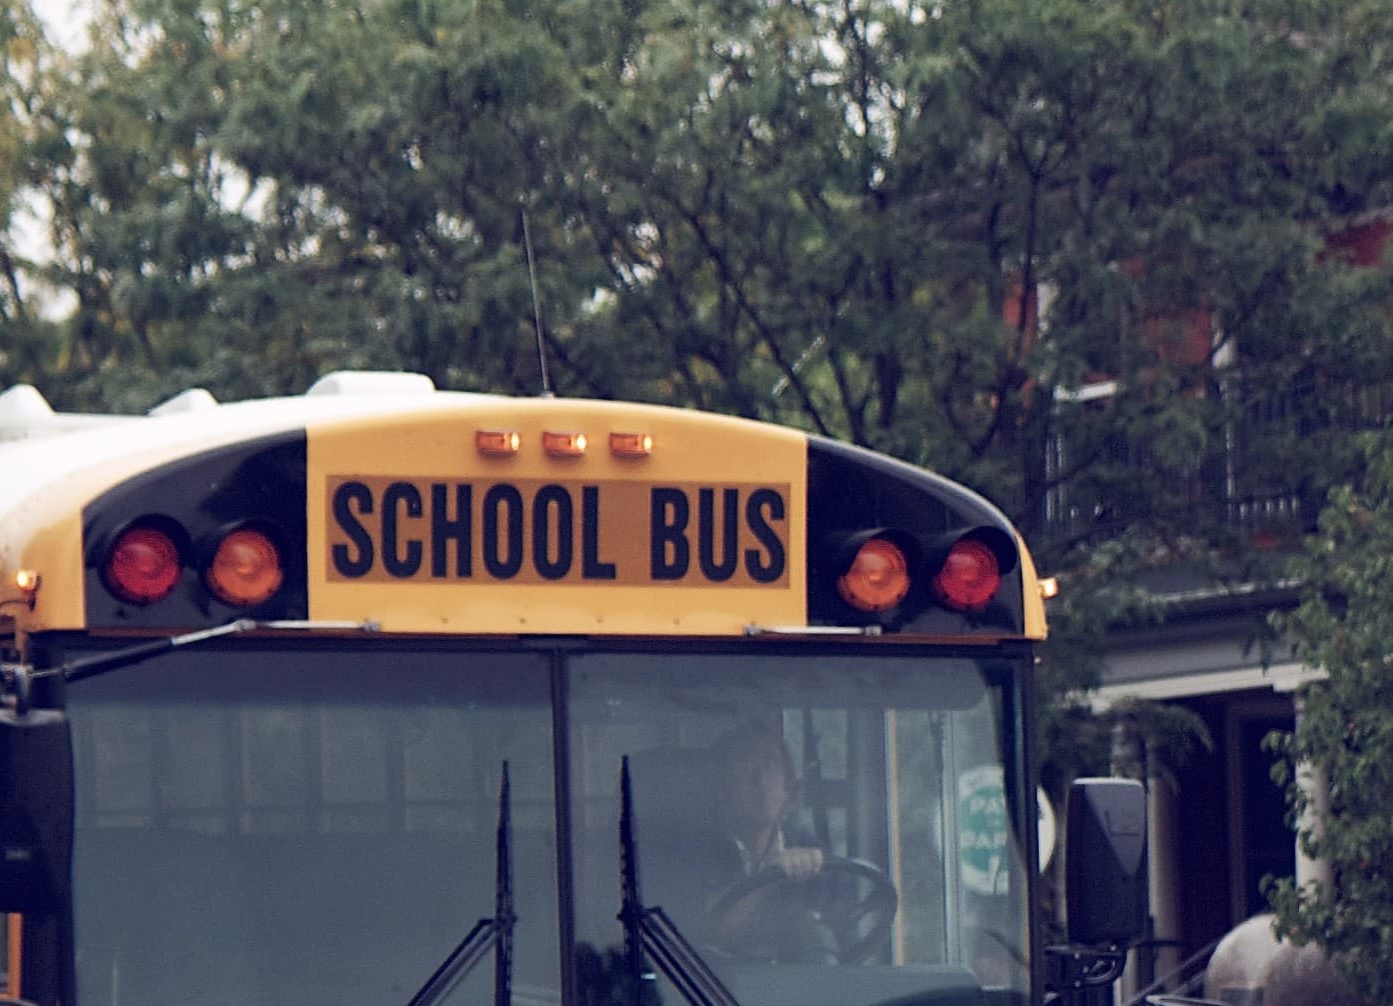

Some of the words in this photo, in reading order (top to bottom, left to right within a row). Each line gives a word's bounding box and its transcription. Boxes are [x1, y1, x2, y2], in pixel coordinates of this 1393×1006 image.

[331, 481, 617, 580] SCHOOL
[650, 486, 786, 583] BUS
[970, 797, 1006, 815] PA
